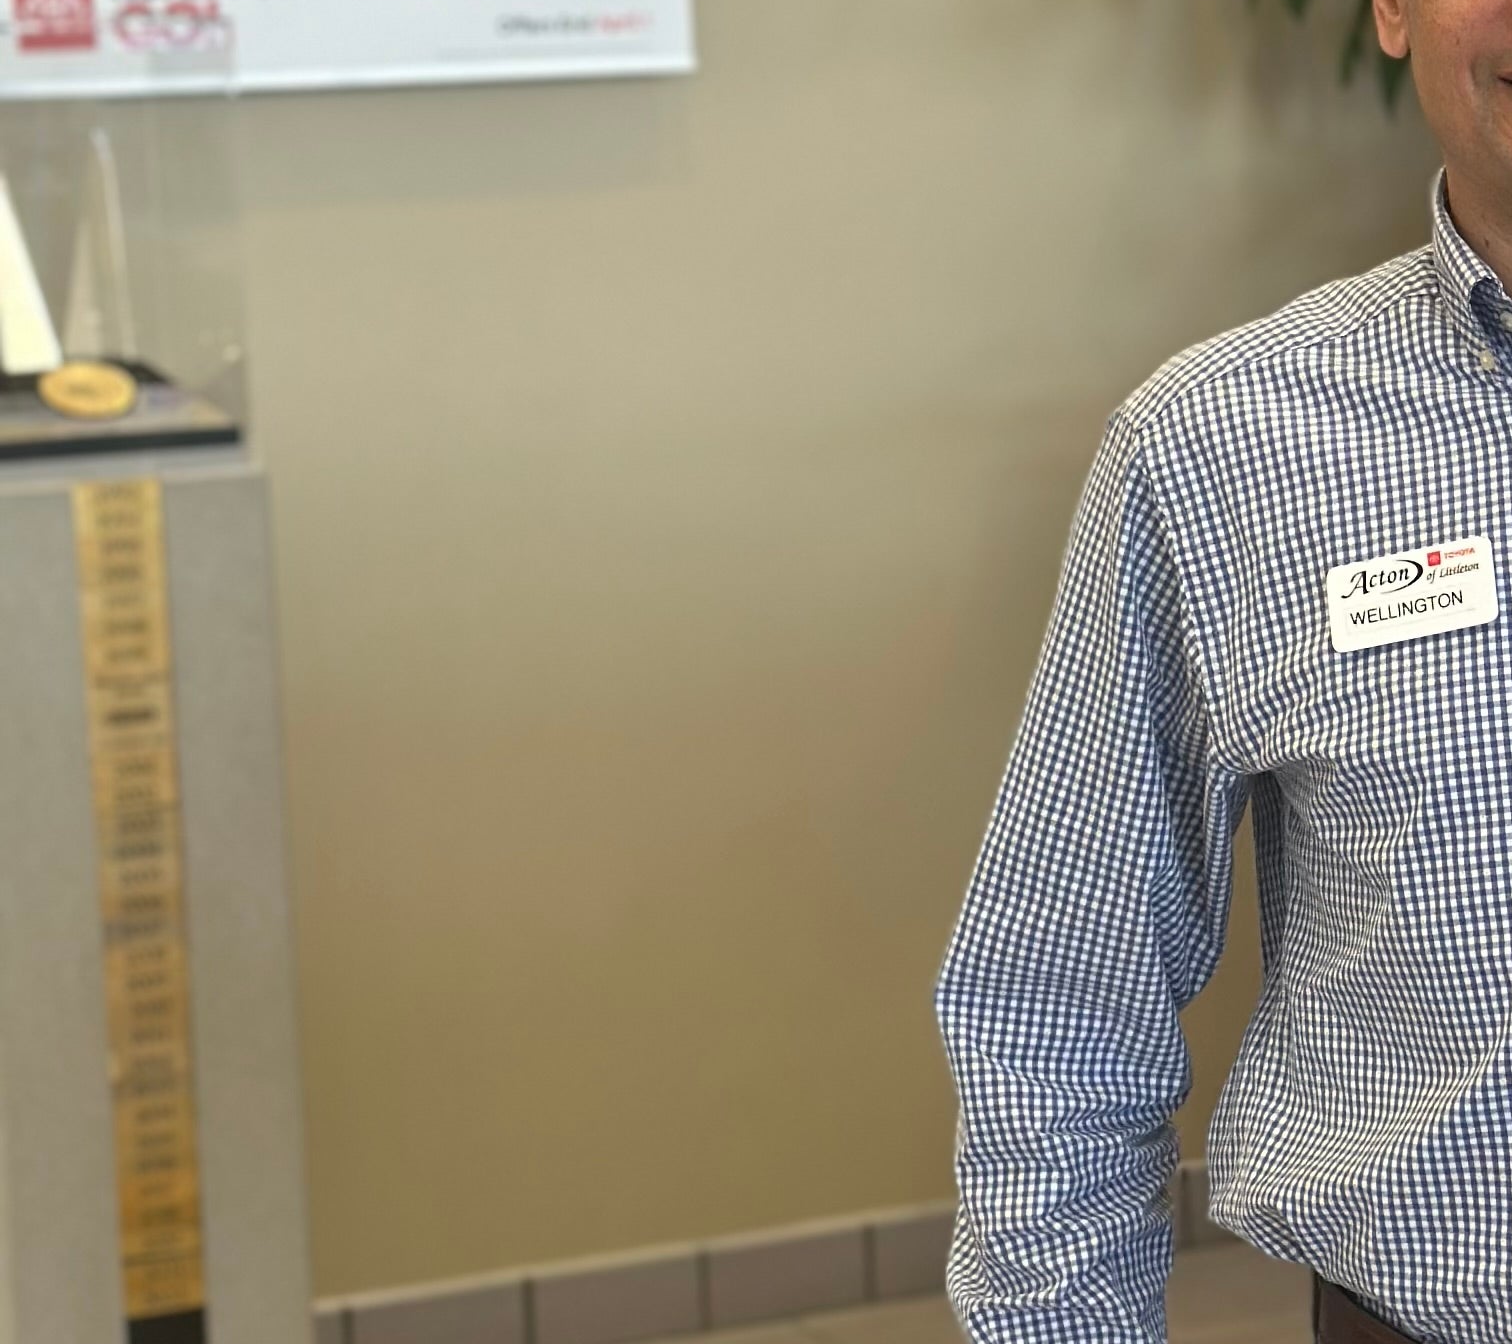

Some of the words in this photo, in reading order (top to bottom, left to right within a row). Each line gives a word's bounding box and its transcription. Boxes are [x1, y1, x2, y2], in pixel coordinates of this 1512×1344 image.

[1444, 547, 1476, 559] TOYOTA
[1341, 568, 1410, 599] Acton
[1427, 569, 1437, 583] of
[1439, 562, 1480, 578] Littleton
[1350, 590, 1463, 625] WELLINGTON
